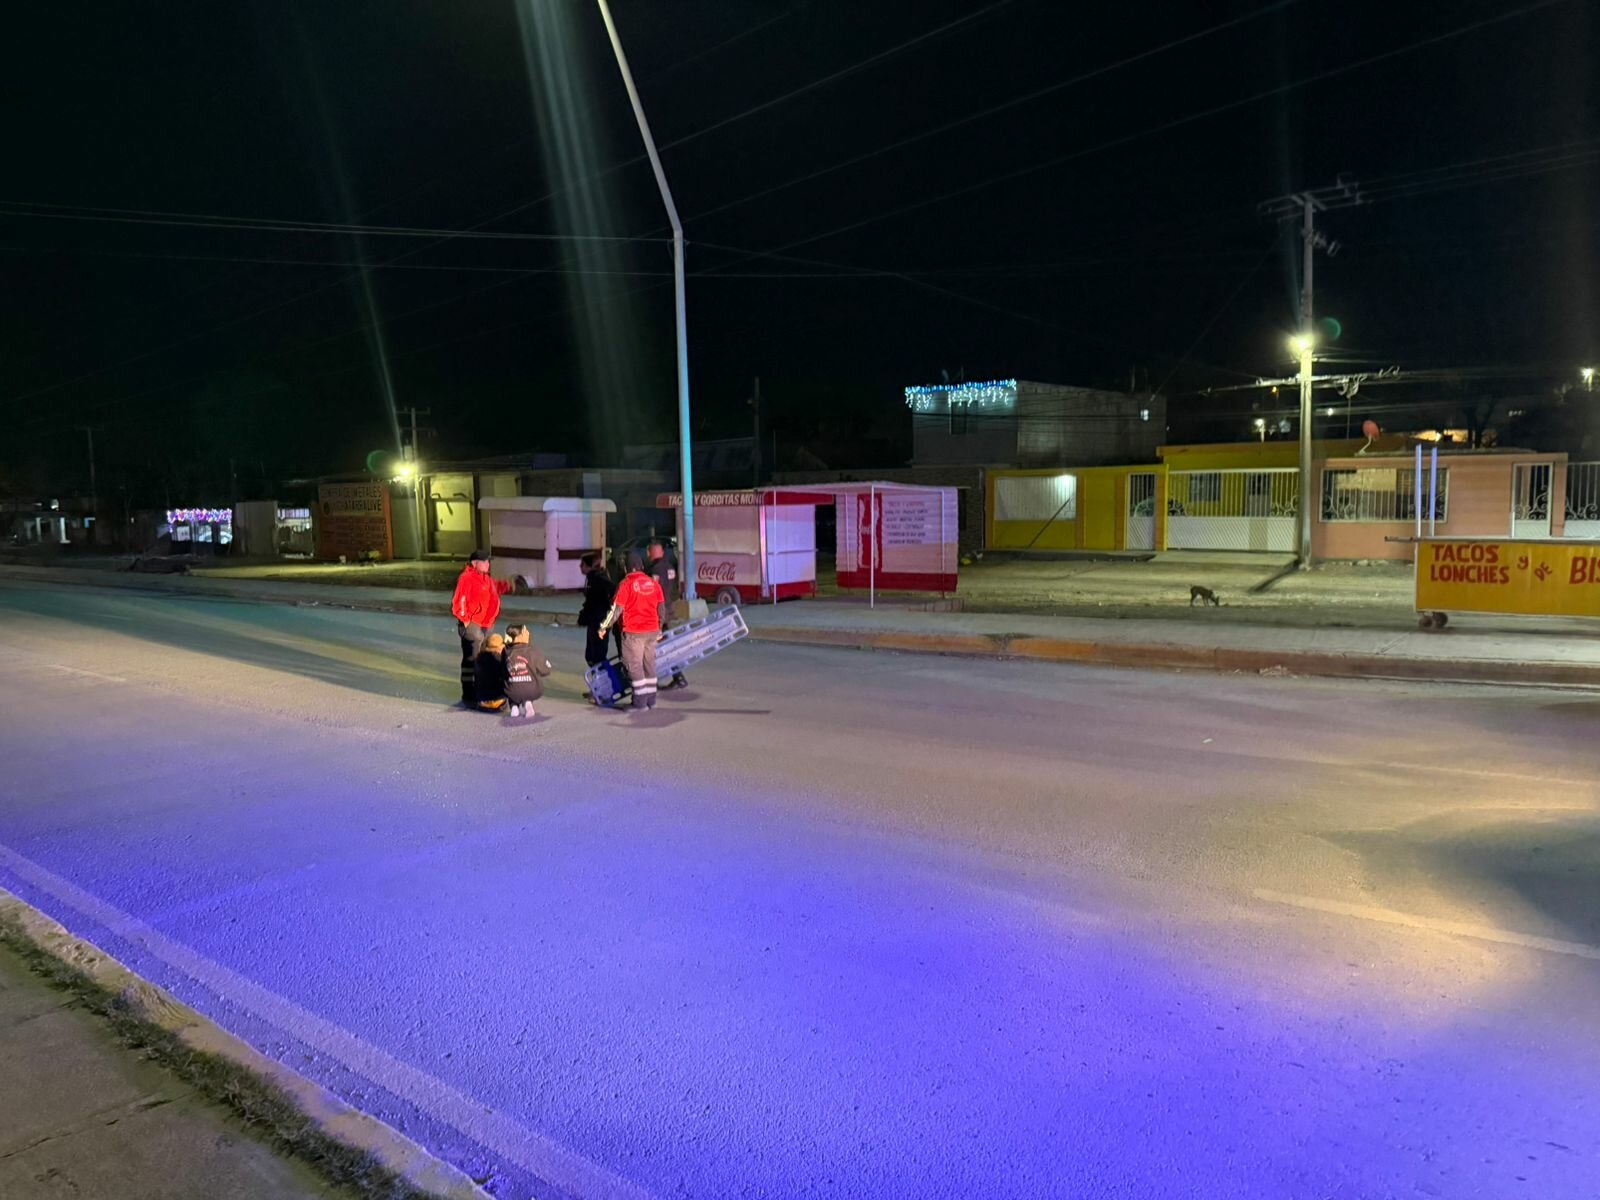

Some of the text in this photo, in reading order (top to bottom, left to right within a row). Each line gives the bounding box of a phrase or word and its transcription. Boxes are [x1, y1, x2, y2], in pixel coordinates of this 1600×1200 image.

[669, 495, 683, 506] TAC
[701, 494, 740, 505] GORDITAS
[1432, 544, 1499, 563] TACOS
[1430, 564, 1510, 585] LONCHES
[1534, 562, 1552, 581] DE
